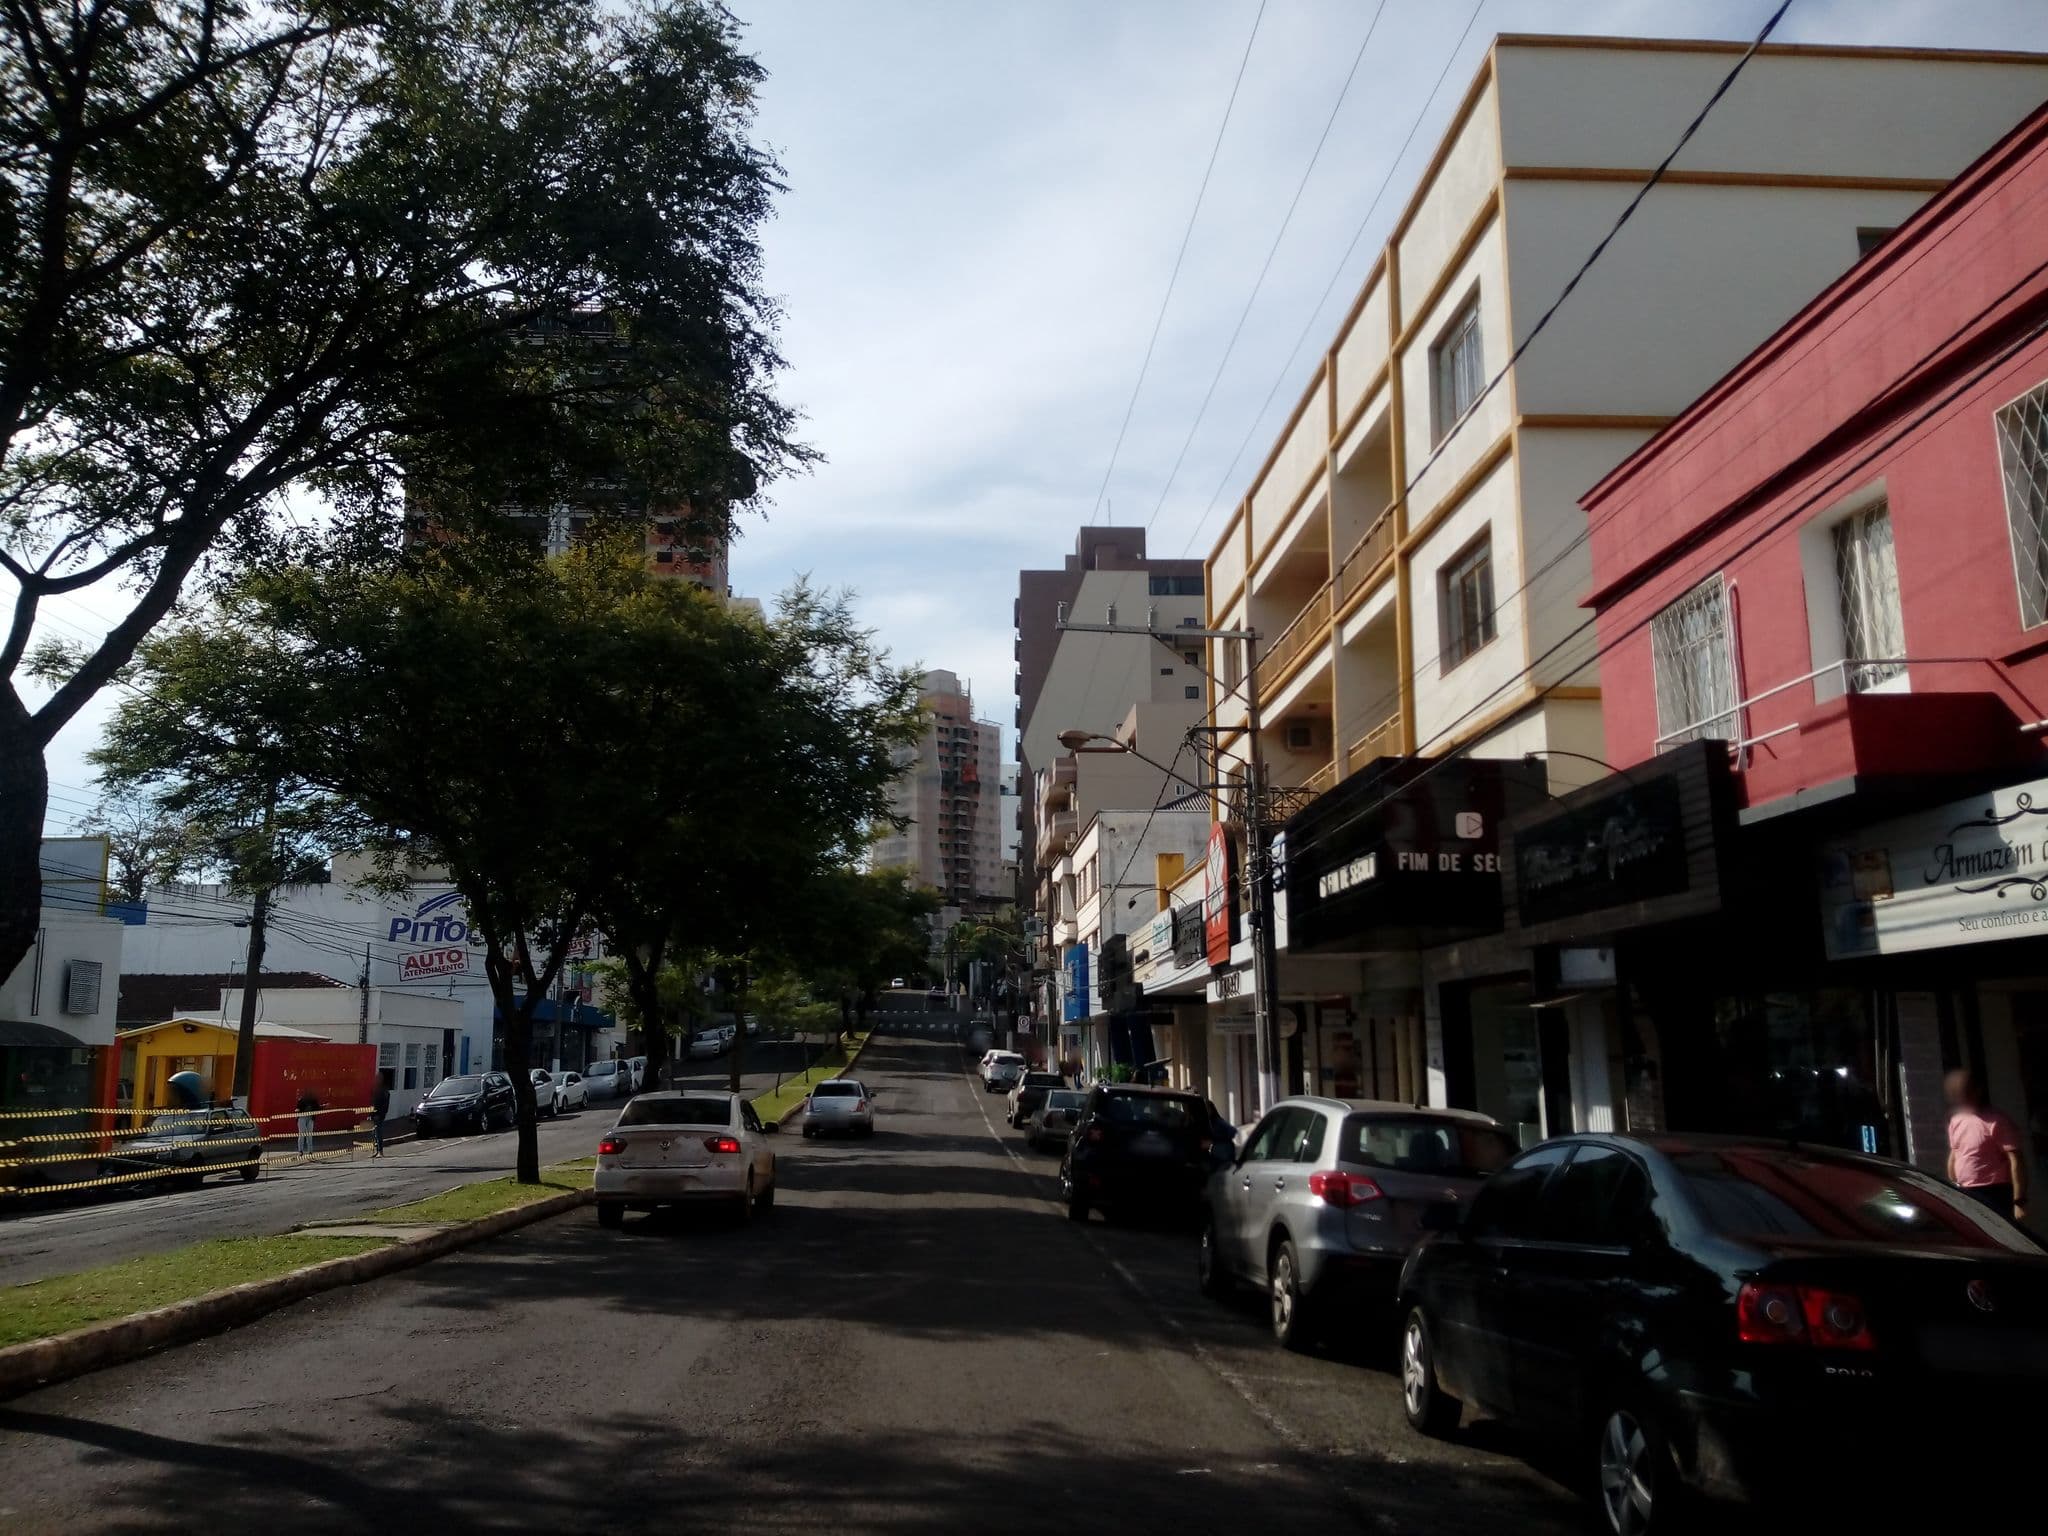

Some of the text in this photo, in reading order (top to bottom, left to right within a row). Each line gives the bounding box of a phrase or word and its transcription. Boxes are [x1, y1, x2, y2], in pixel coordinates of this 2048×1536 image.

[1398, 852, 1429, 872] FIM
[1439, 853, 1462, 872] DE
[1924, 840, 2034, 885] Armazém
[1960, 917, 1979, 931] Seu
[1981, 911, 2029, 928] conforto
[2032, 912, 2040, 923] e
[405, 950, 463, 970] AUTO
[404, 963, 465, 978] ATENDIMENTO
